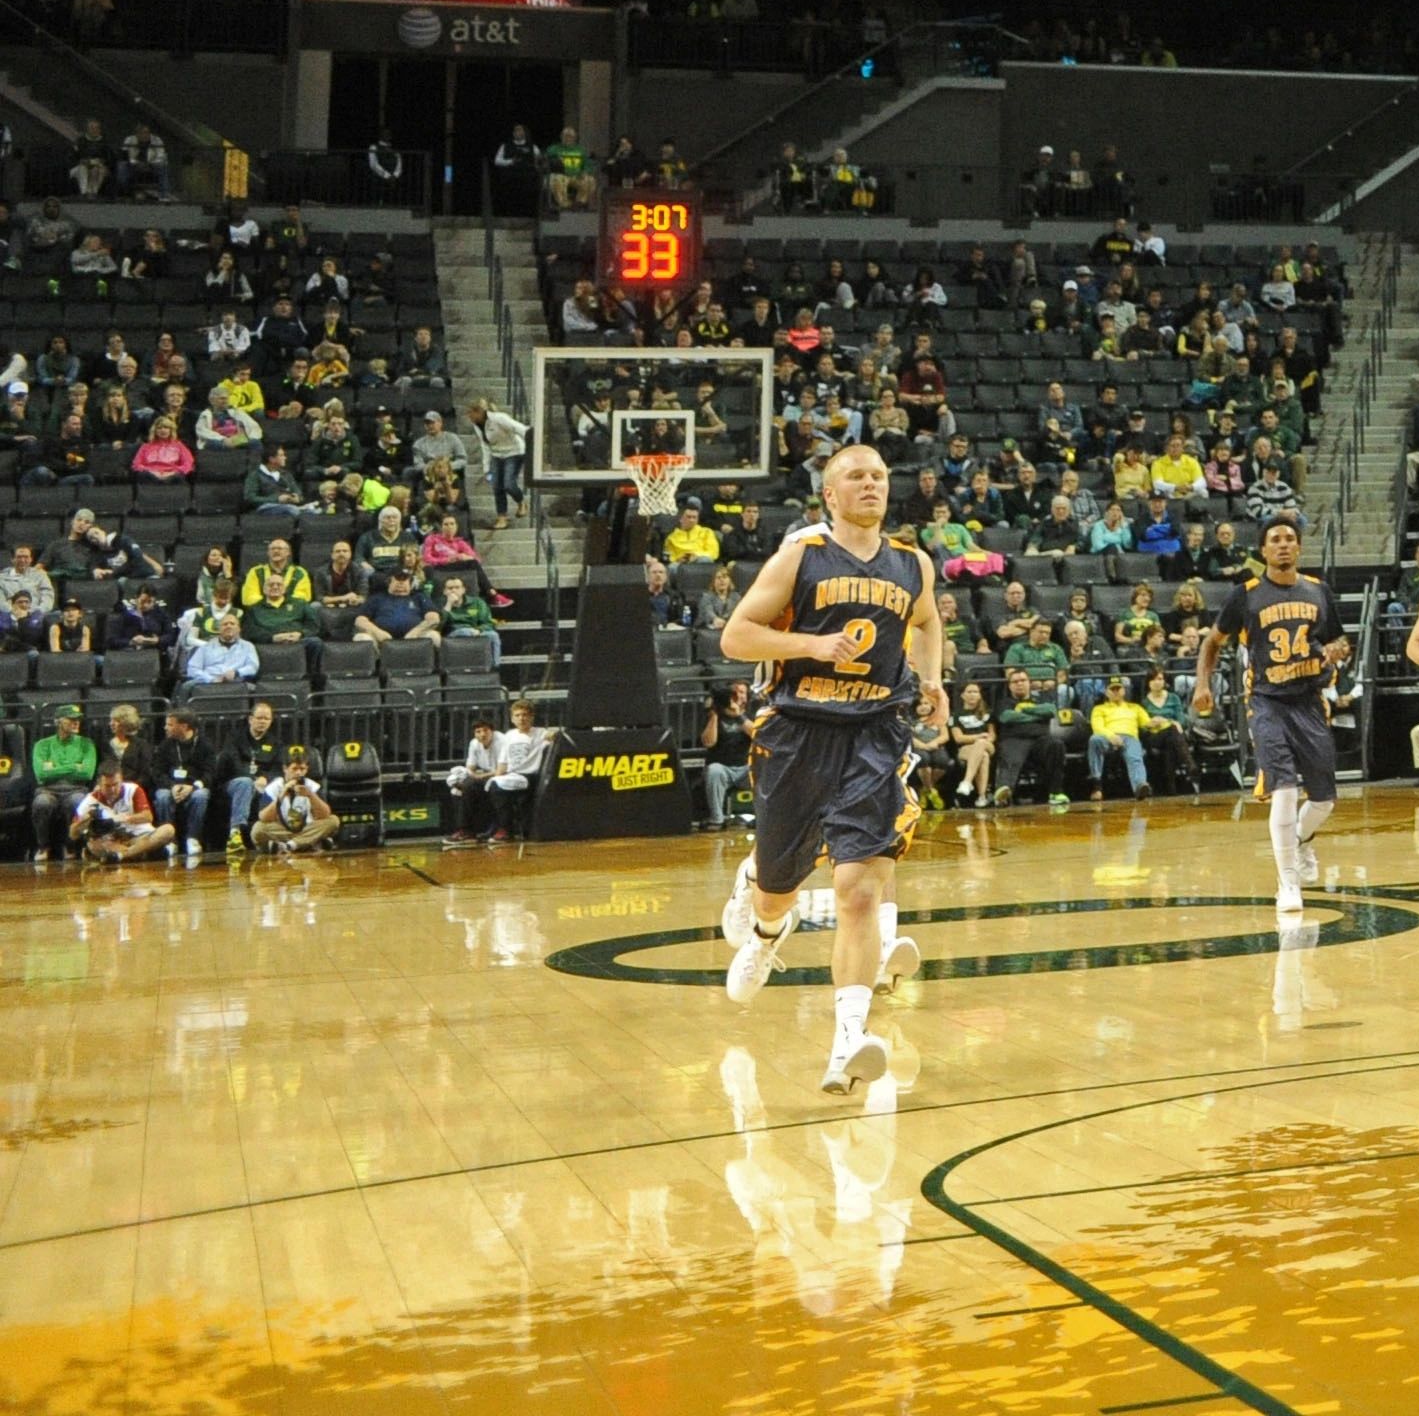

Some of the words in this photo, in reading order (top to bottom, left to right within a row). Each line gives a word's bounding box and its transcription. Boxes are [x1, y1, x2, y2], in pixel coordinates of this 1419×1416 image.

[450, 15, 520, 44] at&t
[632, 204, 687, 232] 3:07
[622, 232, 680, 280] 33
[814, 576, 913, 622] NORTHWEST
[834, 617, 877, 676] 2
[1268, 624, 1311, 664] 34
[616, 774, 639, 788] JUST
[640, 770, 669, 785] RIGHT
